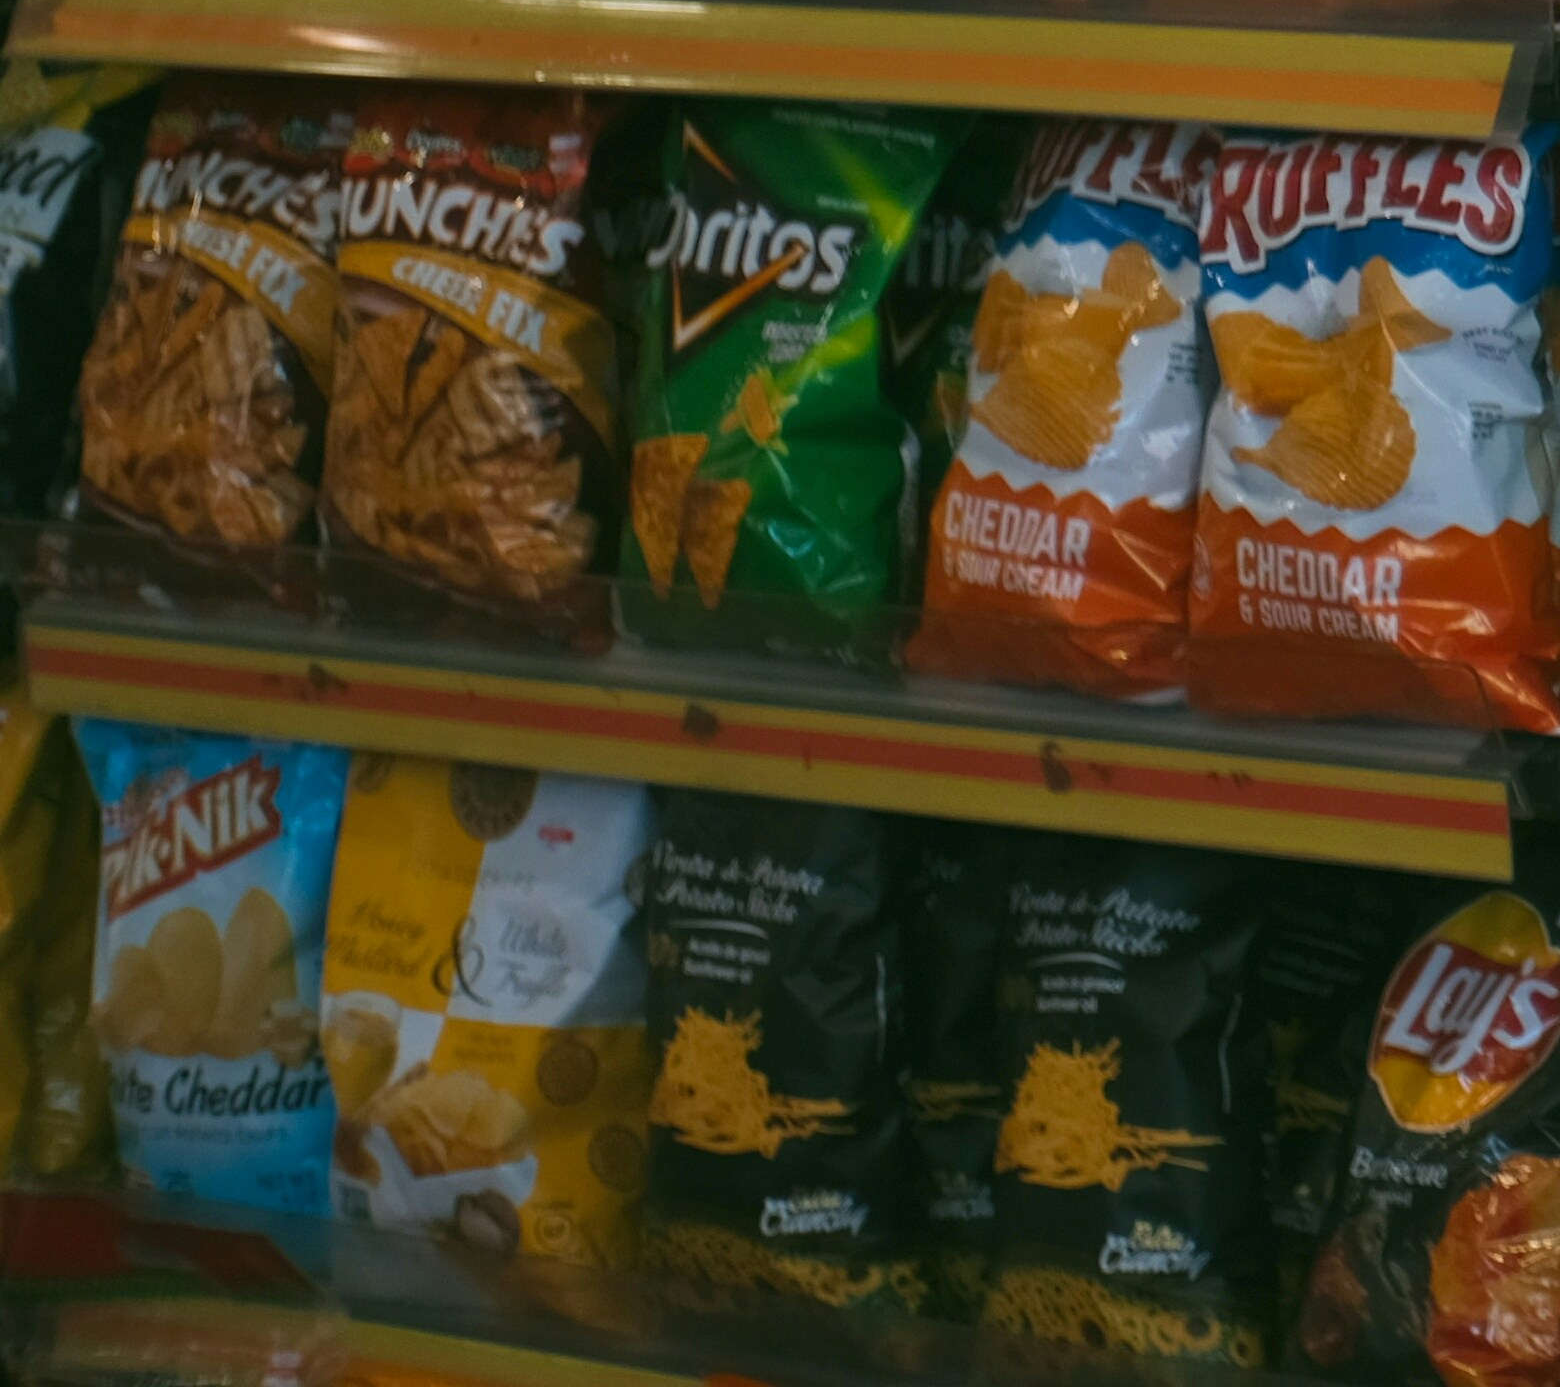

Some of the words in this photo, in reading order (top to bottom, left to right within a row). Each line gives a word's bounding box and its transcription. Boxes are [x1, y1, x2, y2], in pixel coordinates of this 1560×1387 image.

[1203, 137, 1530, 273] RUFFLES
[486, 291, 546, 353] FIX
[944, 489, 1091, 565] CHEDDAR
[1002, 560, 1084, 602] CREAM
[1235, 537, 1402, 606] CHEDDAR
[1260, 605, 1313, 634] SOUR
[1316, 607, 1399, 643] CREAM
[430, 914, 493, 1010] &
[164, 1065, 330, 1119] Cheddar
